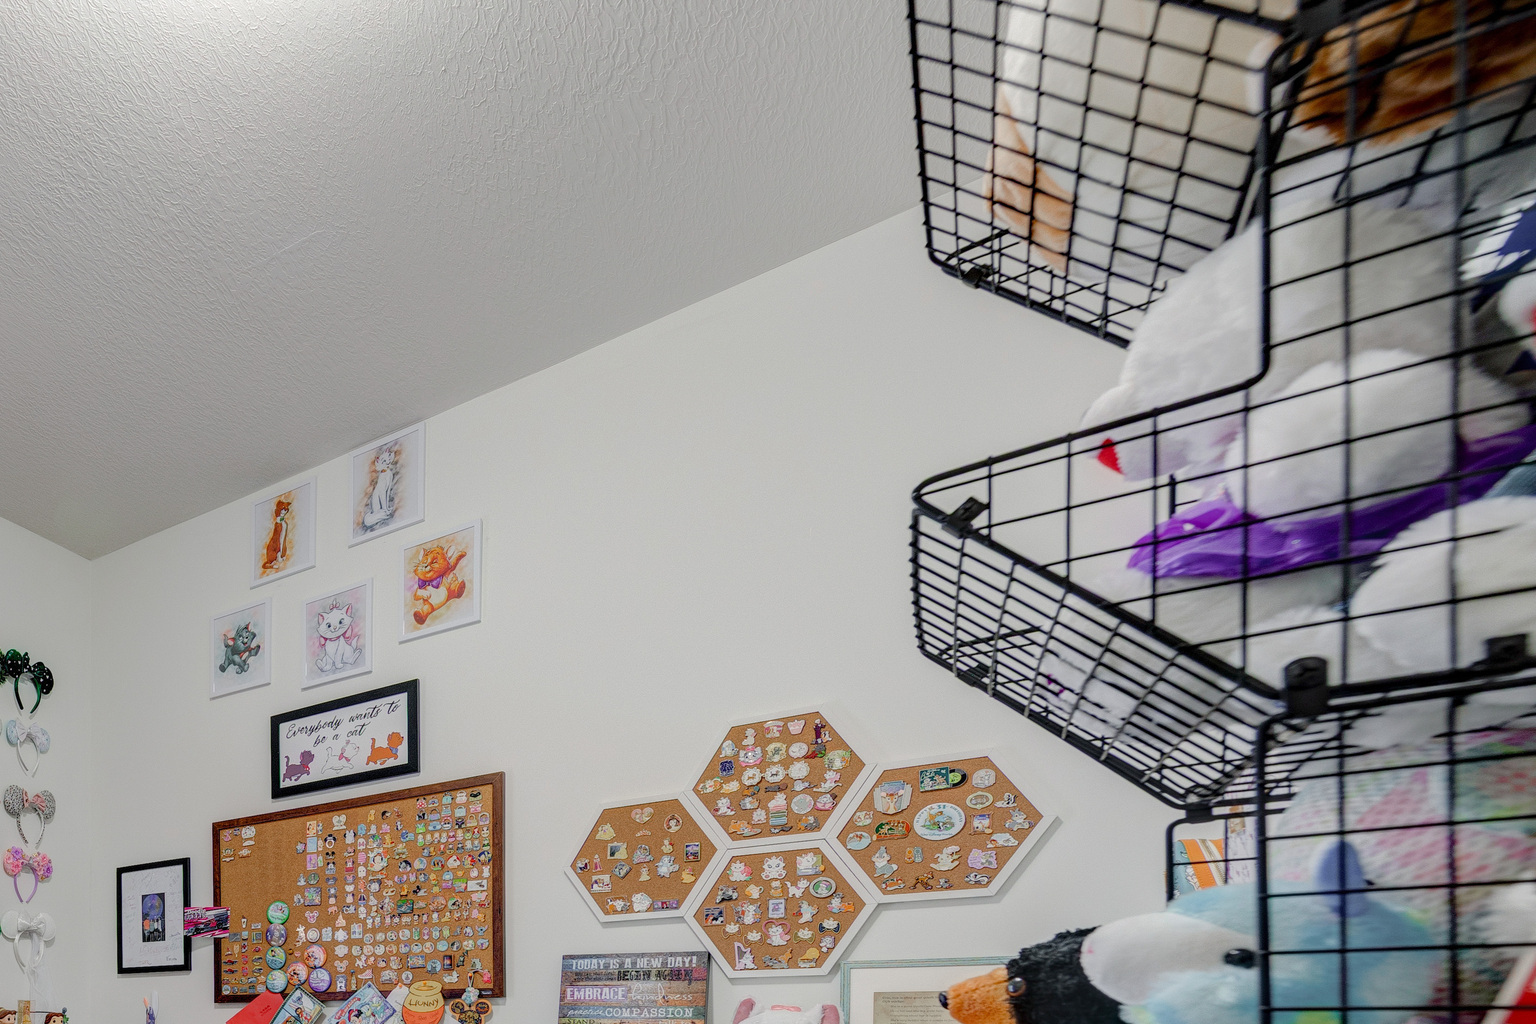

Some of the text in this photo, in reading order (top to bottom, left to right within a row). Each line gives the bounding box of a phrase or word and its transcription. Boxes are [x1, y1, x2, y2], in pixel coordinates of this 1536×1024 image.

[286, 699, 400, 739] Everybody wants to
[313, 735, 327, 747] be
[347, 722, 371, 738] cat
[571, 956, 697, 970] TODAY IS A NEW DAY!
[617, 970, 652, 981] BEGIN
[655, 969, 693, 981] AGAIN
[566, 987, 626, 1000] EMBRACE
[408, 999, 439, 1008] HUNNY
[606, 1008, 693, 1017] COMPASSION
